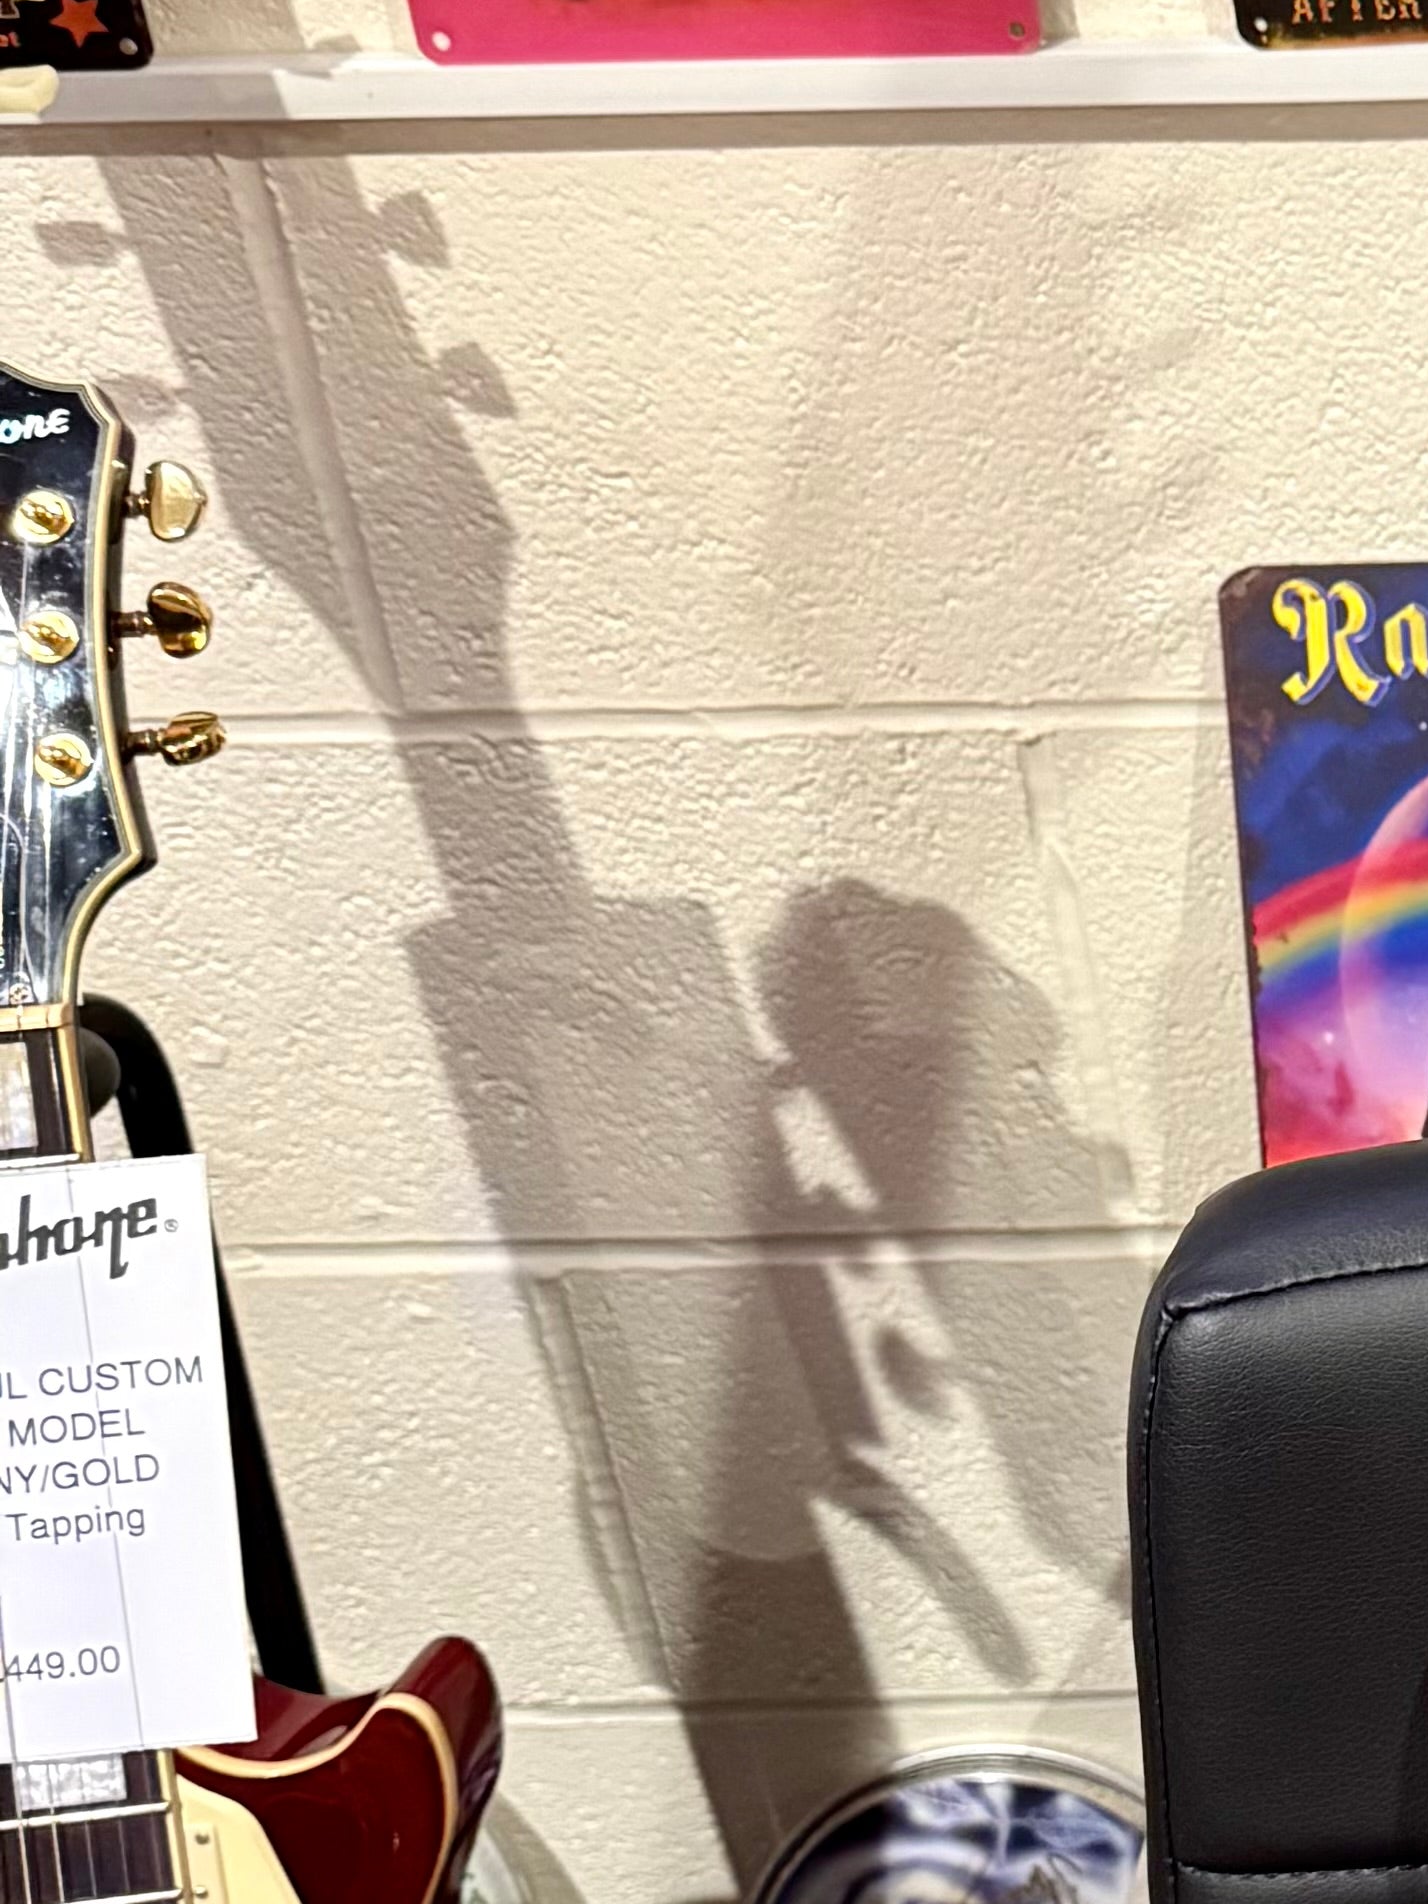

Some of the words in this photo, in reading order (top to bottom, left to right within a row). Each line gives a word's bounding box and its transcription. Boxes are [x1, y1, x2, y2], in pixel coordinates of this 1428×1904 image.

[38, 1355, 204, 1397] CUSTOM
[8, 1408, 146, 1448] MODEL
[5, 1505, 147, 1546] Tapping
[0, 1645, 121, 1683] 449.00
